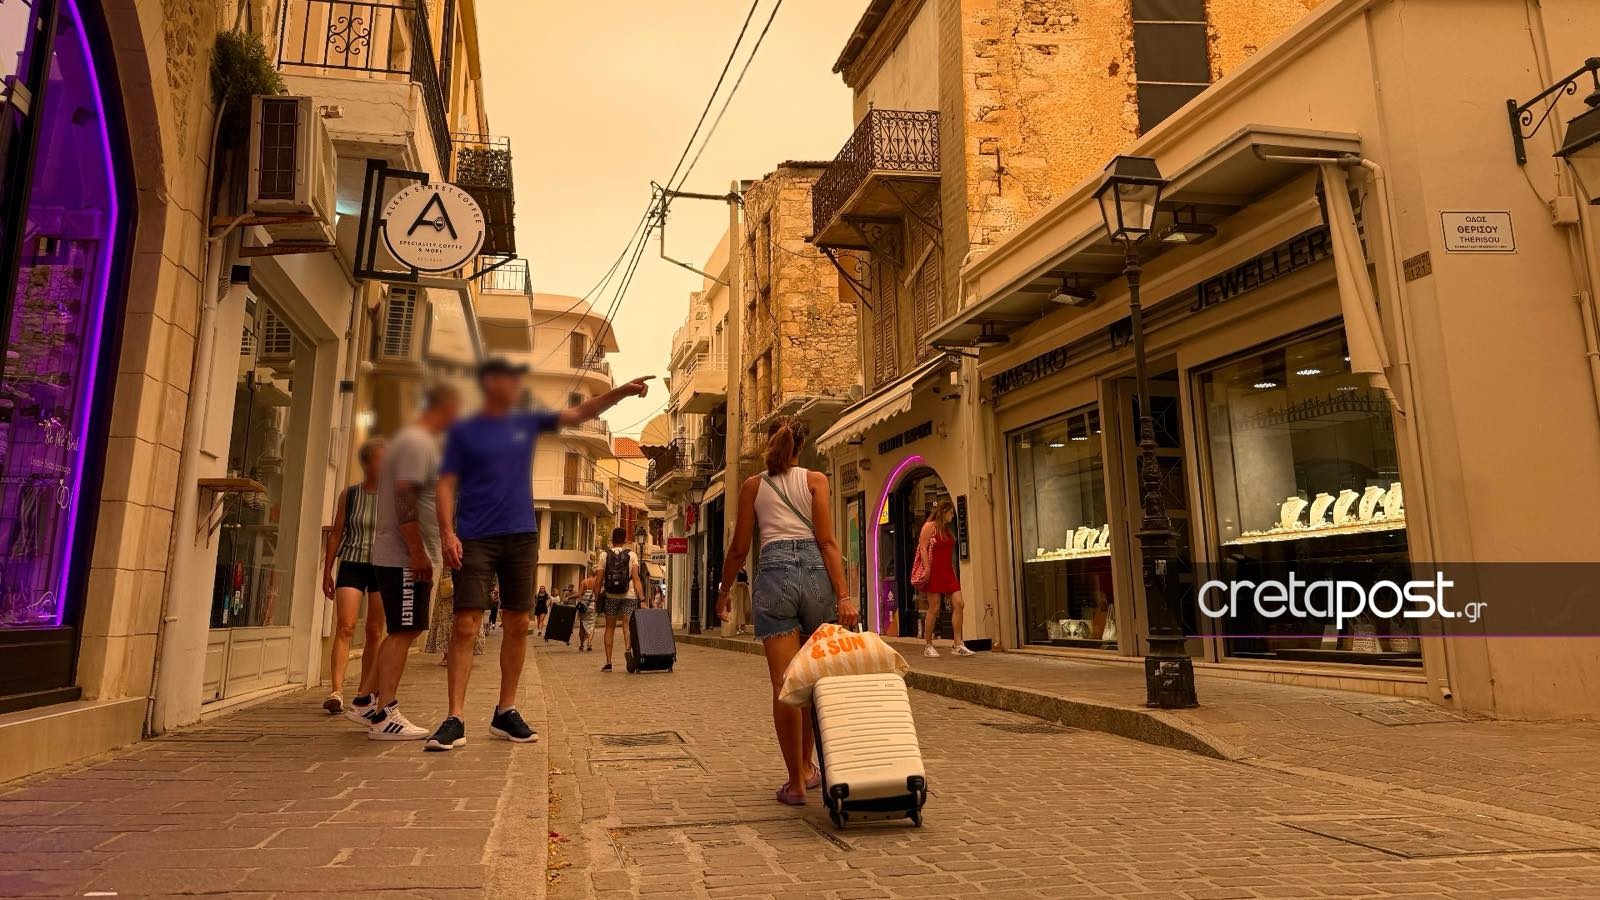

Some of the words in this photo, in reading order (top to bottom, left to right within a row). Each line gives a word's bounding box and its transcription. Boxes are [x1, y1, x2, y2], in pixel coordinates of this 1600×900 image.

[386, 191, 410, 217] ALEXX
[414, 184, 453, 193] STREET
[457, 192, 482, 224] COFFEE
[1457, 225, 1498, 234] ΘΕΡΙΣΟΥ
[439, 243, 463, 251] COFFEE
[1460, 236, 1500, 244] THERISOU
[994, 347, 1067, 395] MAESTRO
[811, 644, 826, 660] &
[828, 637, 865, 656] SUN
